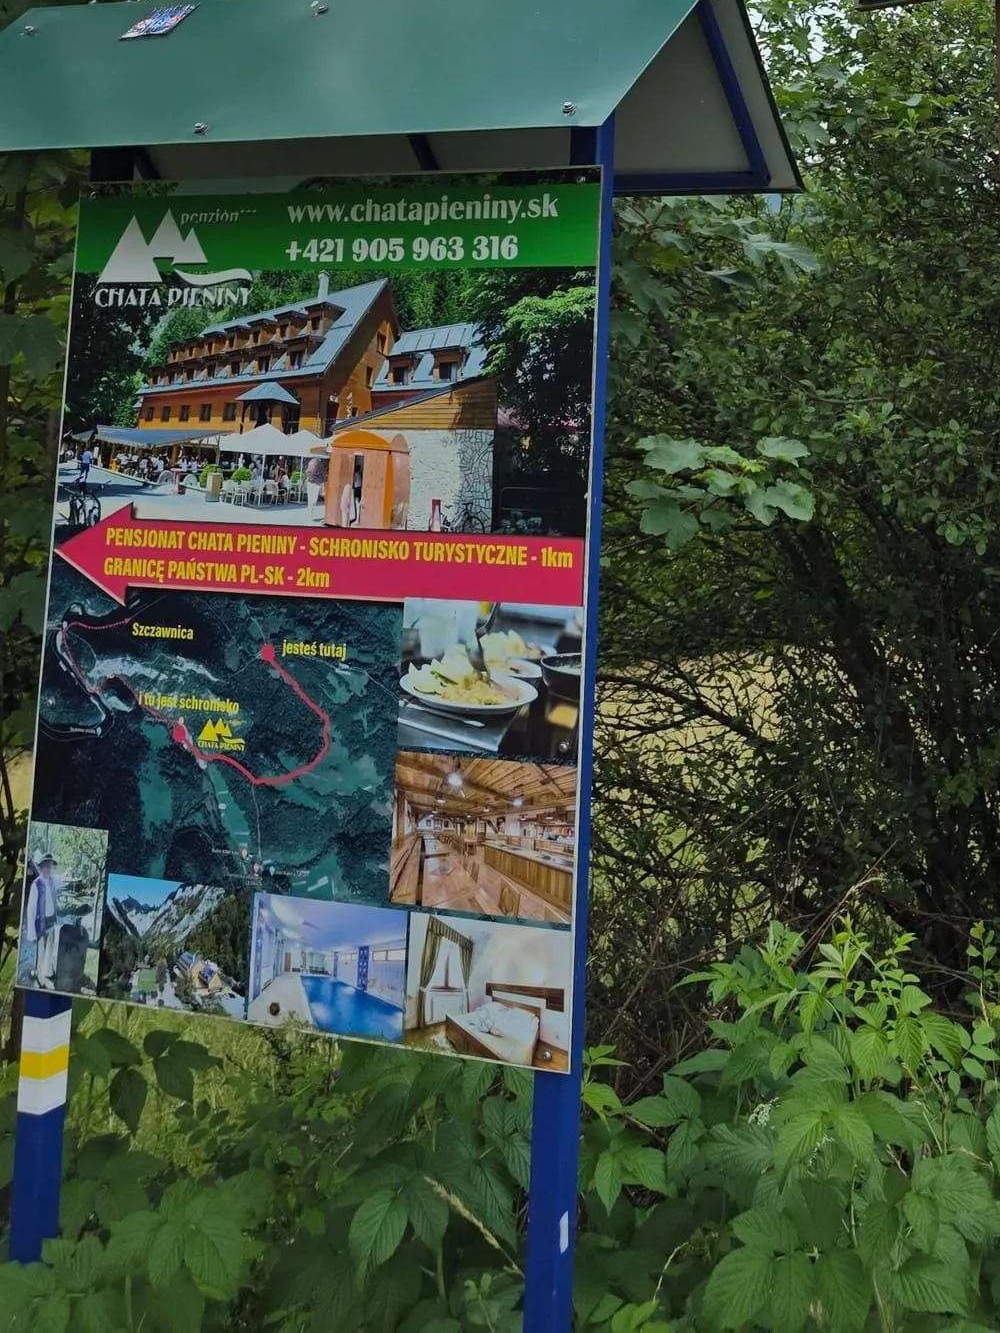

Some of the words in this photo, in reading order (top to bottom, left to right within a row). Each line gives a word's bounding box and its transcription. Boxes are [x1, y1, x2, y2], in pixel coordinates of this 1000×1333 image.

[287, 193, 559, 226] www.chatapieniny.sk
[285, 238, 345, 263] +421
[352, 237, 405, 263] 905
[411, 236, 464, 262] 963
[472, 235, 519, 261] 316
[95, 288, 162, 308] CHATA
[167, 287, 254, 308] PIENINY
[106, 527, 185, 548] PENSJONAT
[188, 531, 233, 552] CHATA
[236, 534, 297, 554] PIENINY
[309, 537, 410, 561] SCHRONISKO
[413, 541, 528, 566] TURYSTYCZNE
[540, 546, 573, 568] 1km
[104, 557, 164, 584] GRANICĘ
[168, 558, 237, 583] PAŃSTWA
[240, 564, 285, 585] PL-SK
[296, 567, 330, 588] 2km
[132, 622, 194, 640] Szczawnica
[281, 640, 317, 657] jesteś
[319, 642, 347, 661] tutaj
[144, 693, 156, 706] tu
[156, 693, 178, 709] jest
[179, 696, 240, 715] schronisko
